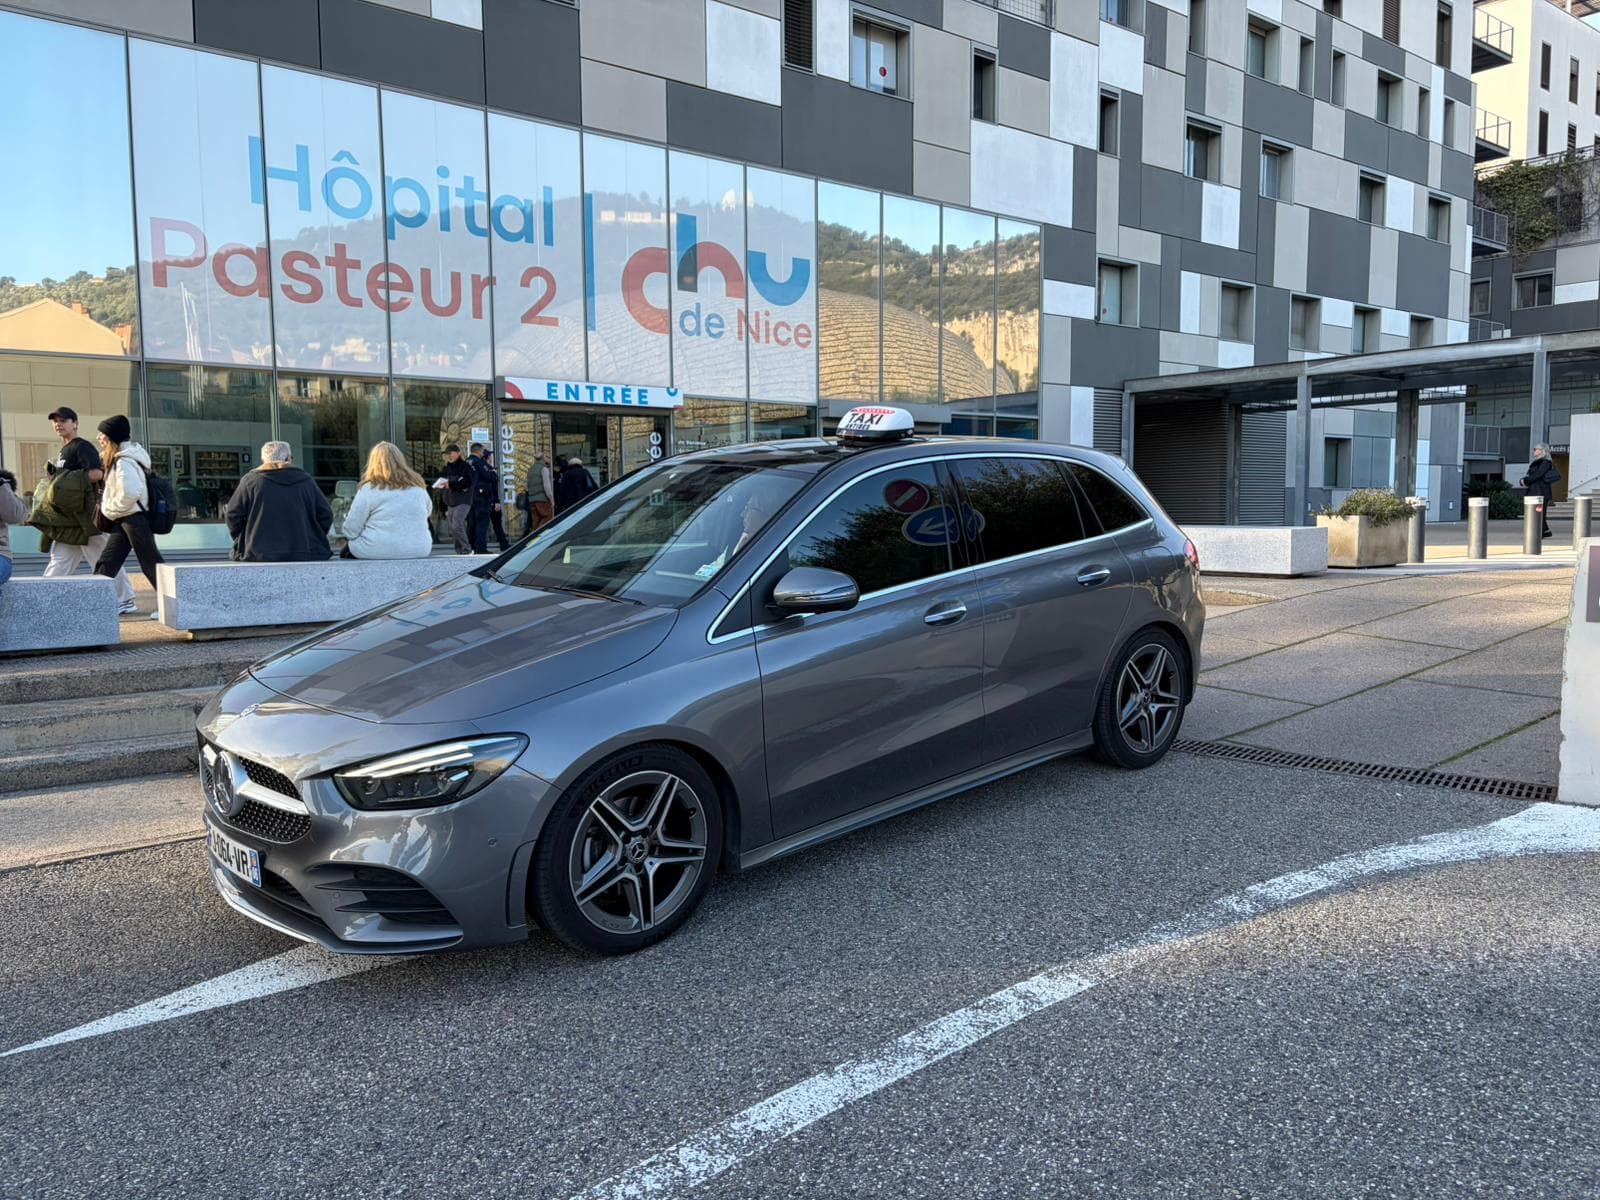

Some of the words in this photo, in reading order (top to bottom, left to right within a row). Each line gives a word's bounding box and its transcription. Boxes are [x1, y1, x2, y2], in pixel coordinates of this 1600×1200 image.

[248, 135, 554, 247] Hôpital
[149, 216, 497, 320] Pasteur
[519, 266, 560, 327] 2
[679, 302, 725, 339] de
[736, 308, 812, 349] Nice
[547, 382, 649, 405] ENTRÉE
[849, 412, 884, 425] TAXI
